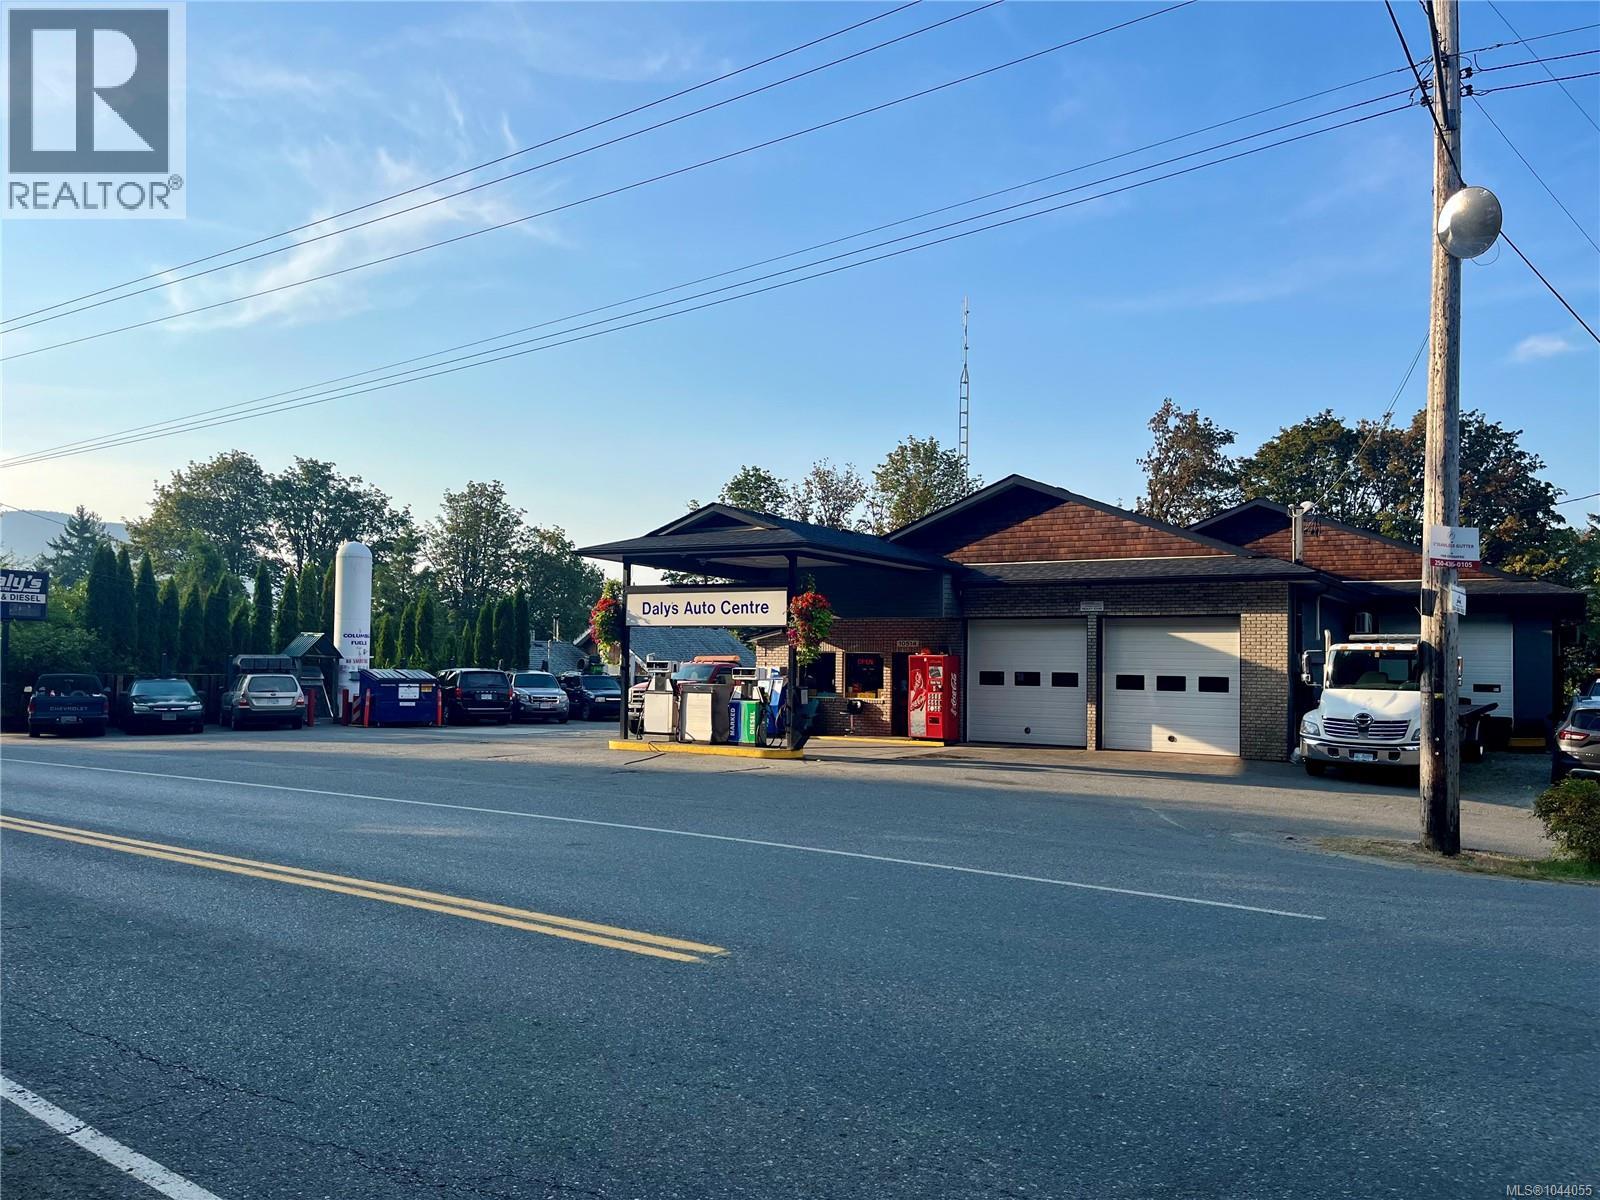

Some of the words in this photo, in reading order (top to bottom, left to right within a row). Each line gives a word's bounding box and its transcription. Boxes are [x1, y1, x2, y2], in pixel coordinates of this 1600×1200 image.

[10, 594, 41, 602] DIESEL
[642, 601, 679, 617] Dalys
[684, 601, 716, 615] Auto
[720, 600, 769, 614] Centre
